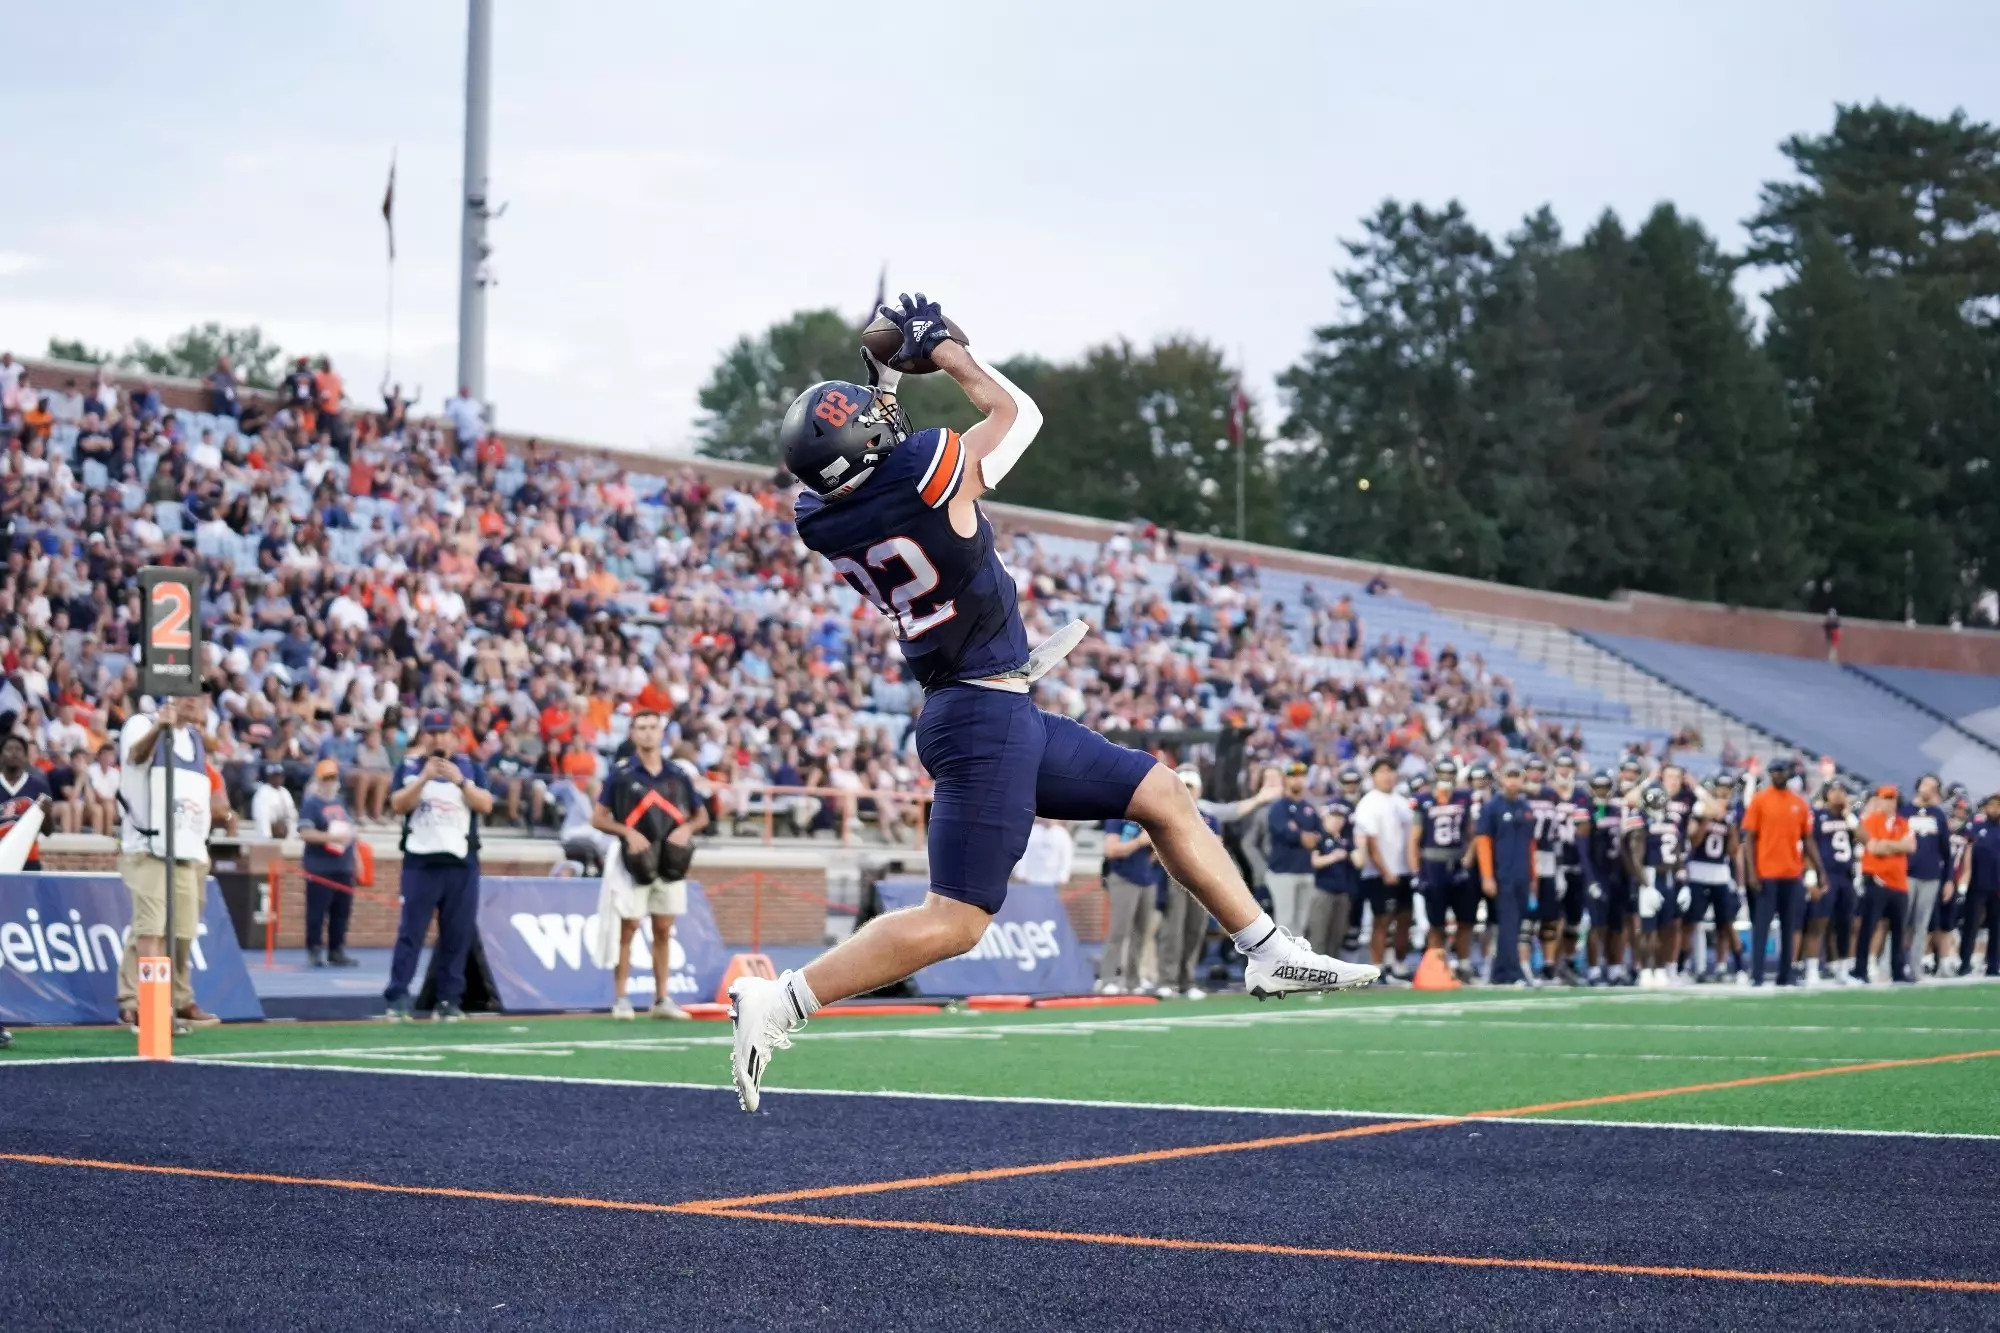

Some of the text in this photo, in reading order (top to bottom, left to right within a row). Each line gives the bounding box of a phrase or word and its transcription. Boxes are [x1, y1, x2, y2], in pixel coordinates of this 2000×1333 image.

[915, 320, 934, 342] adidas
[815, 391, 859, 428] 82
[151, 581, 192, 650] 2
[1660, 832, 1679, 865] 2
[0, 908, 208, 974] eisinr
[1271, 965, 1339, 985] ADIZERO
